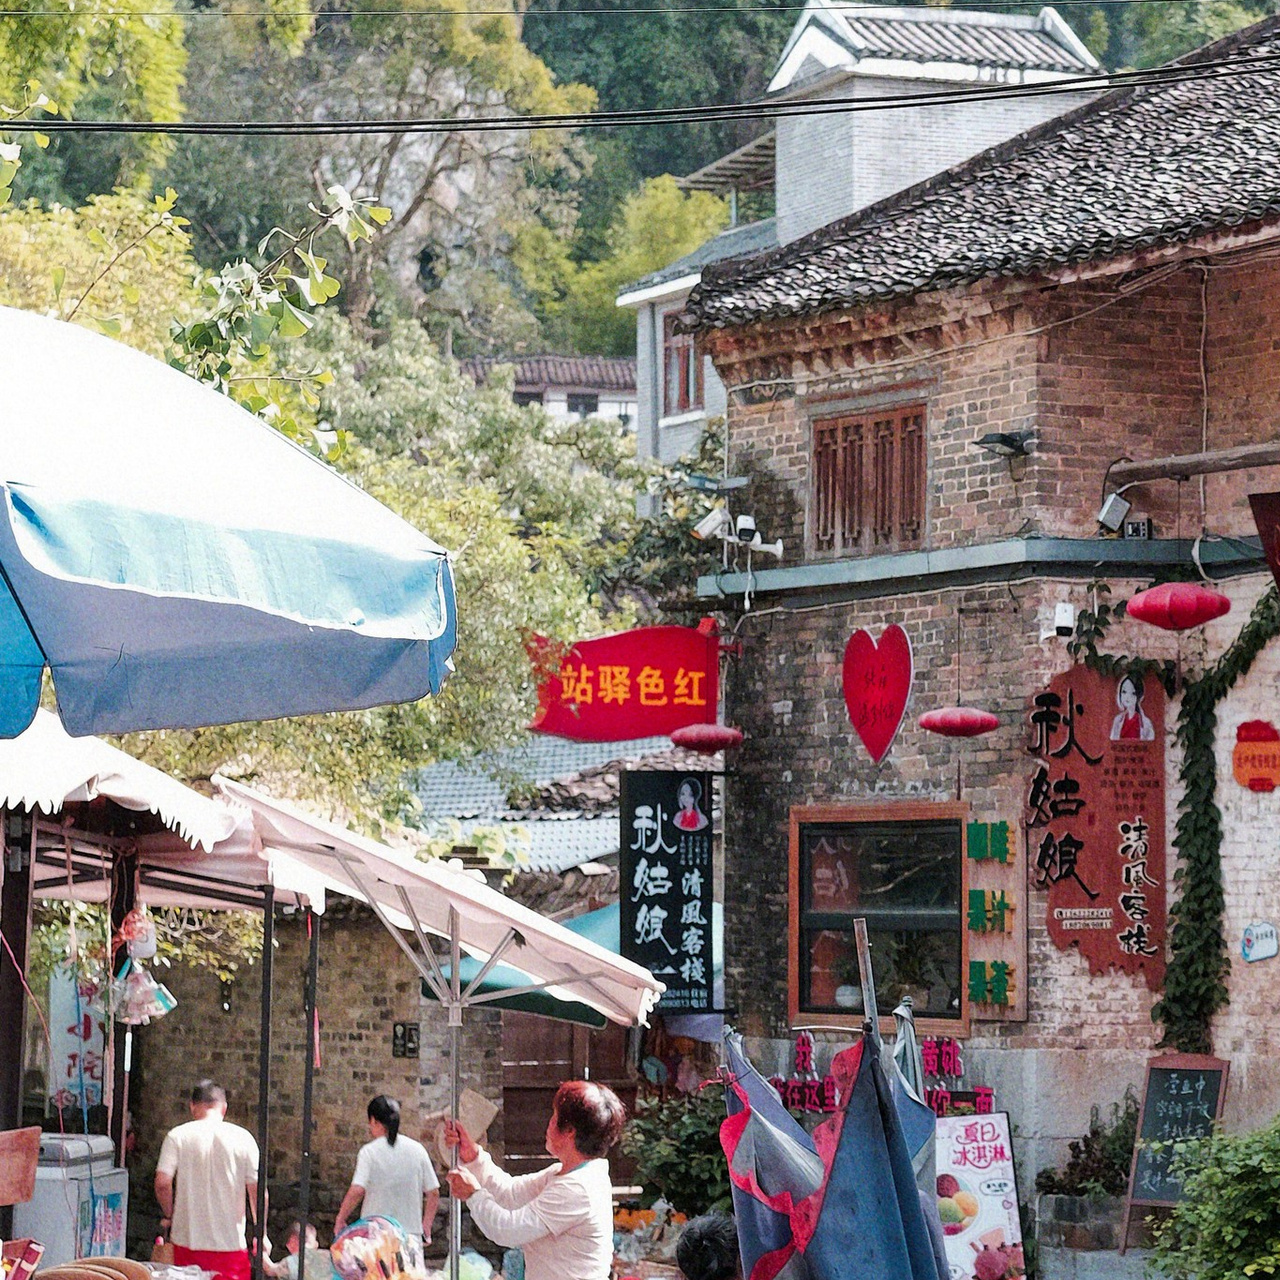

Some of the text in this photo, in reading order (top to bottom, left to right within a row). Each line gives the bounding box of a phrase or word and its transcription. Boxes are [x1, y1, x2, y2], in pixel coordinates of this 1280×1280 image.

[1027, 688, 1105, 901] 秋姑娘
[630, 802, 678, 955] 秋姑娘
[967, 889, 1010, 934] 果汁
[967, 960, 1010, 1006] 果茶
[795, 1032, 815, 1073] 我
[955, 1122, 1000, 1145] 夏日
[952, 1144, 1012, 1169] 冰淇淋
